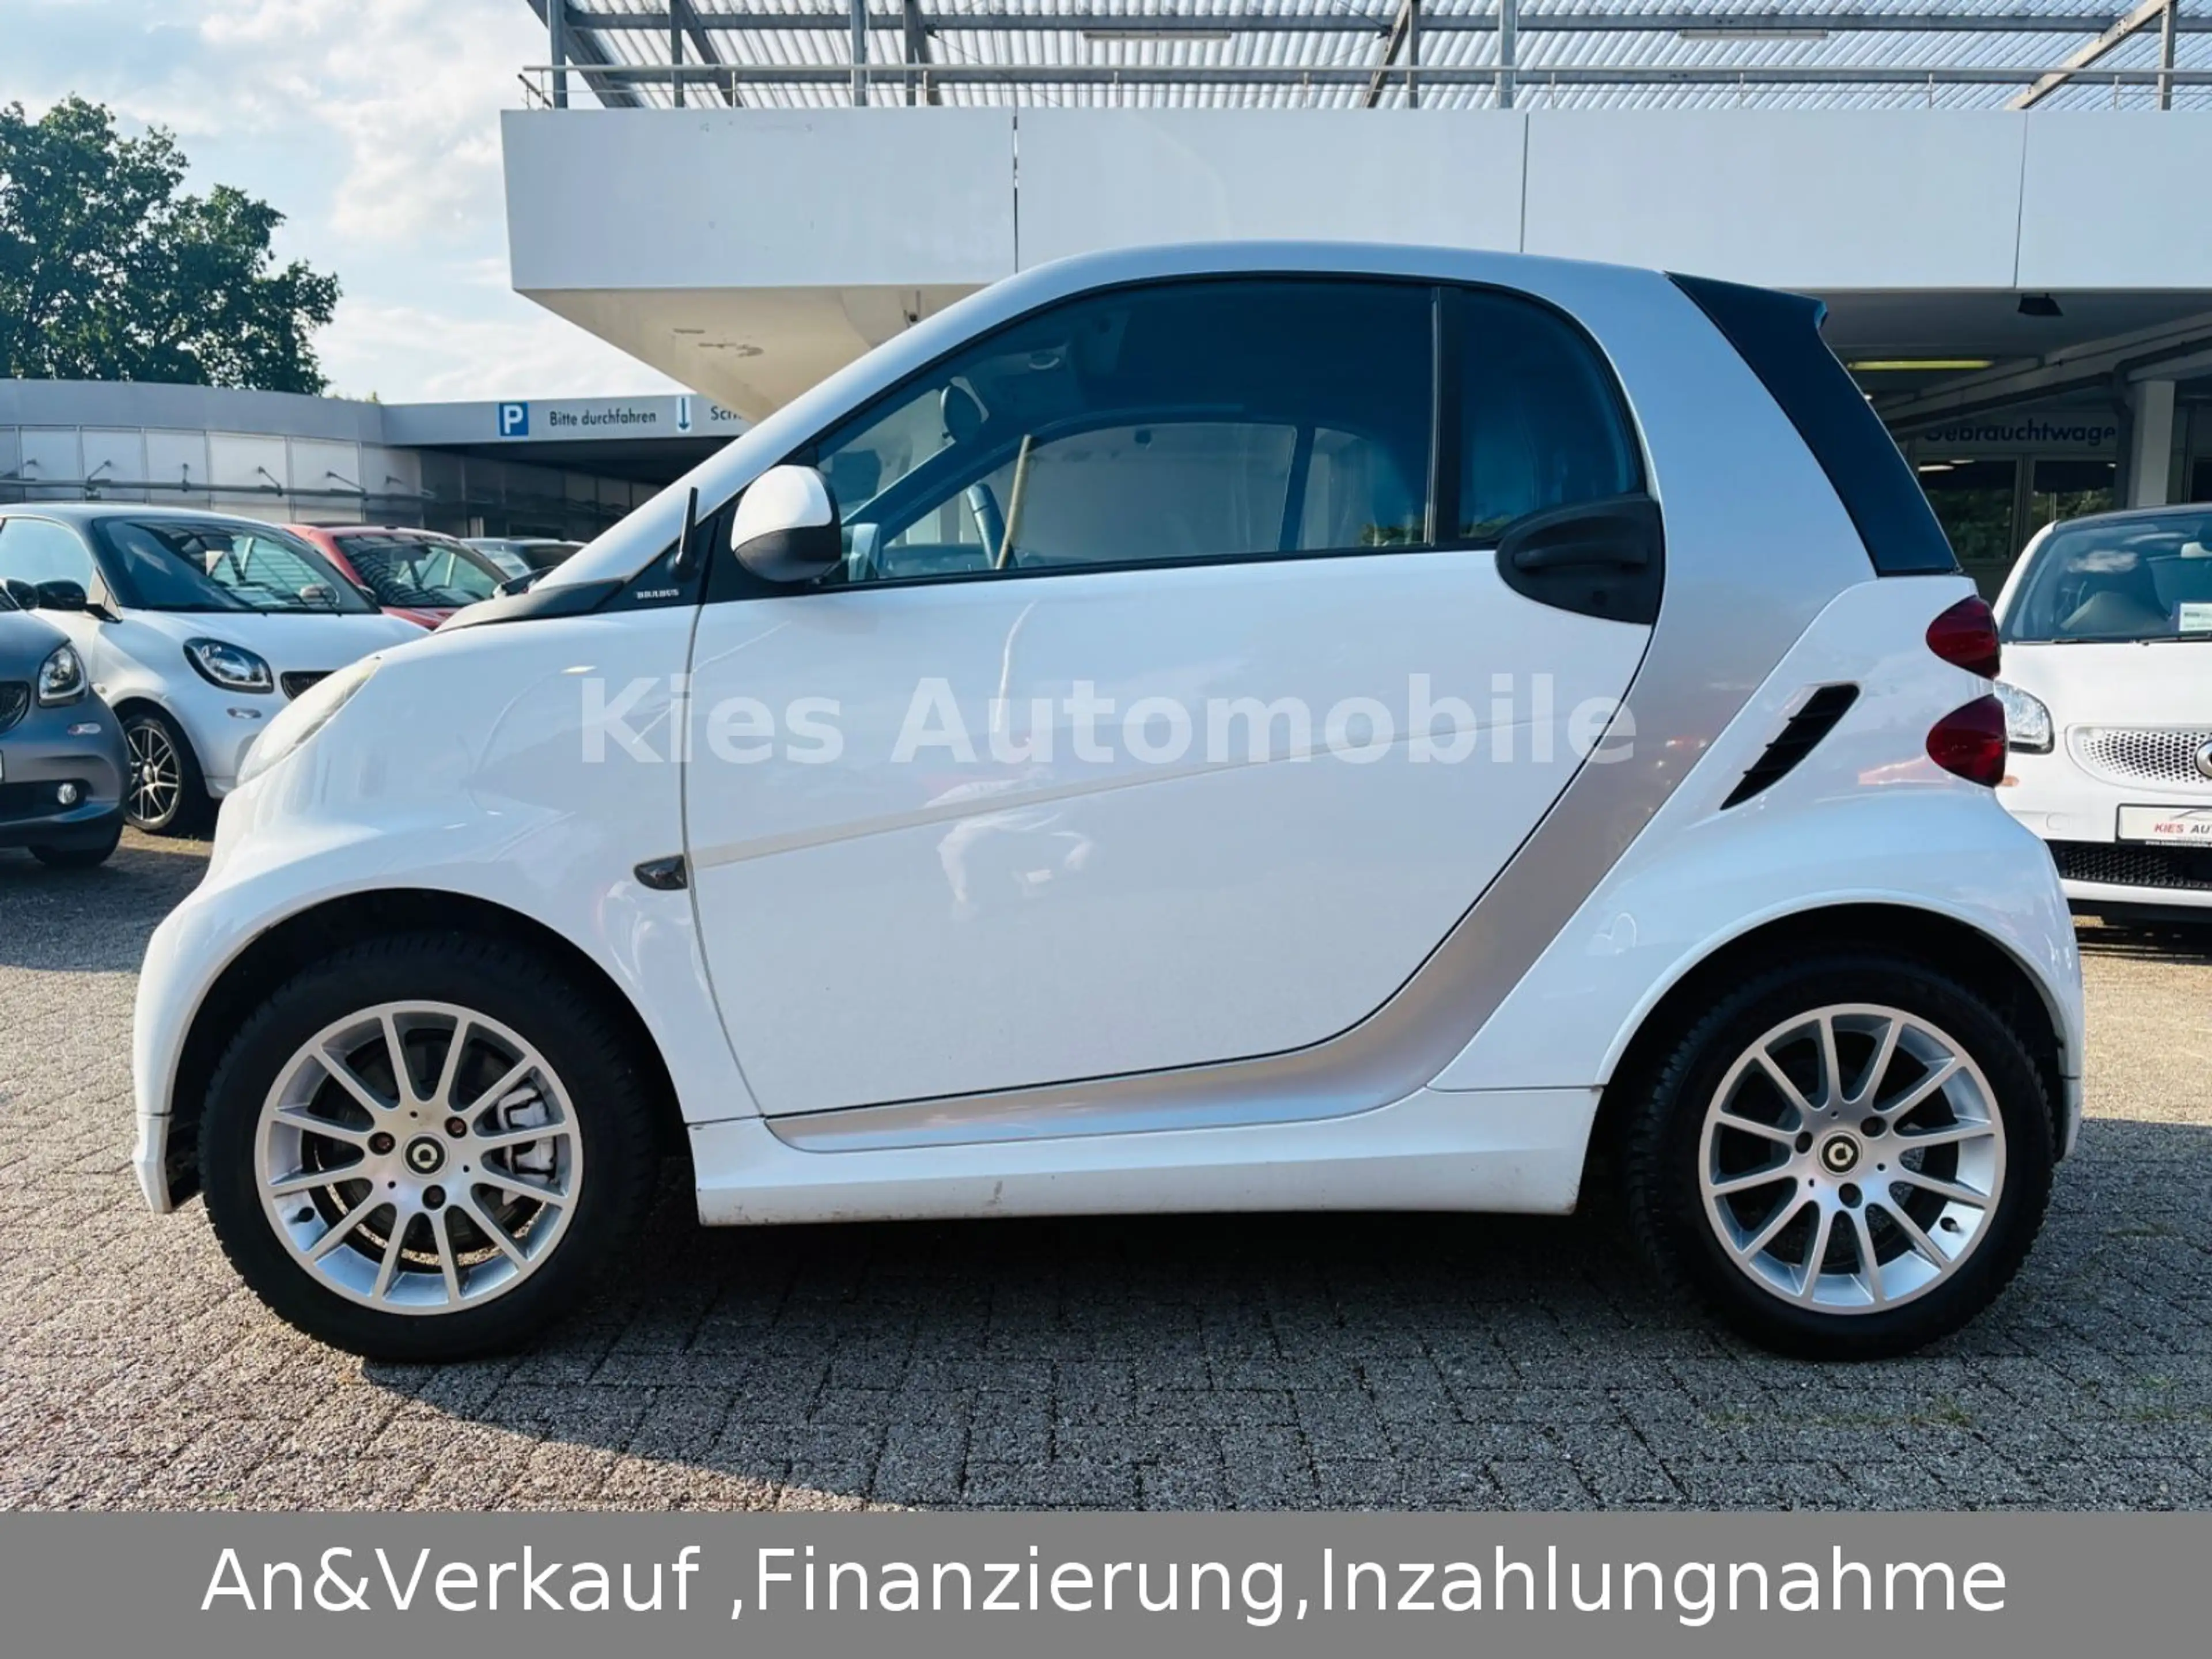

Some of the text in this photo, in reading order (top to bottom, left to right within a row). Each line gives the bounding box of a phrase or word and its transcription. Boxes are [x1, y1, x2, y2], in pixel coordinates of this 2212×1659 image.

[503, 405, 523, 434] P
[550, 408, 656, 426] Bitte durchfahren
[635, 588, 680, 599] BRABUS
[2154, 823, 2212, 834] KIES AU
